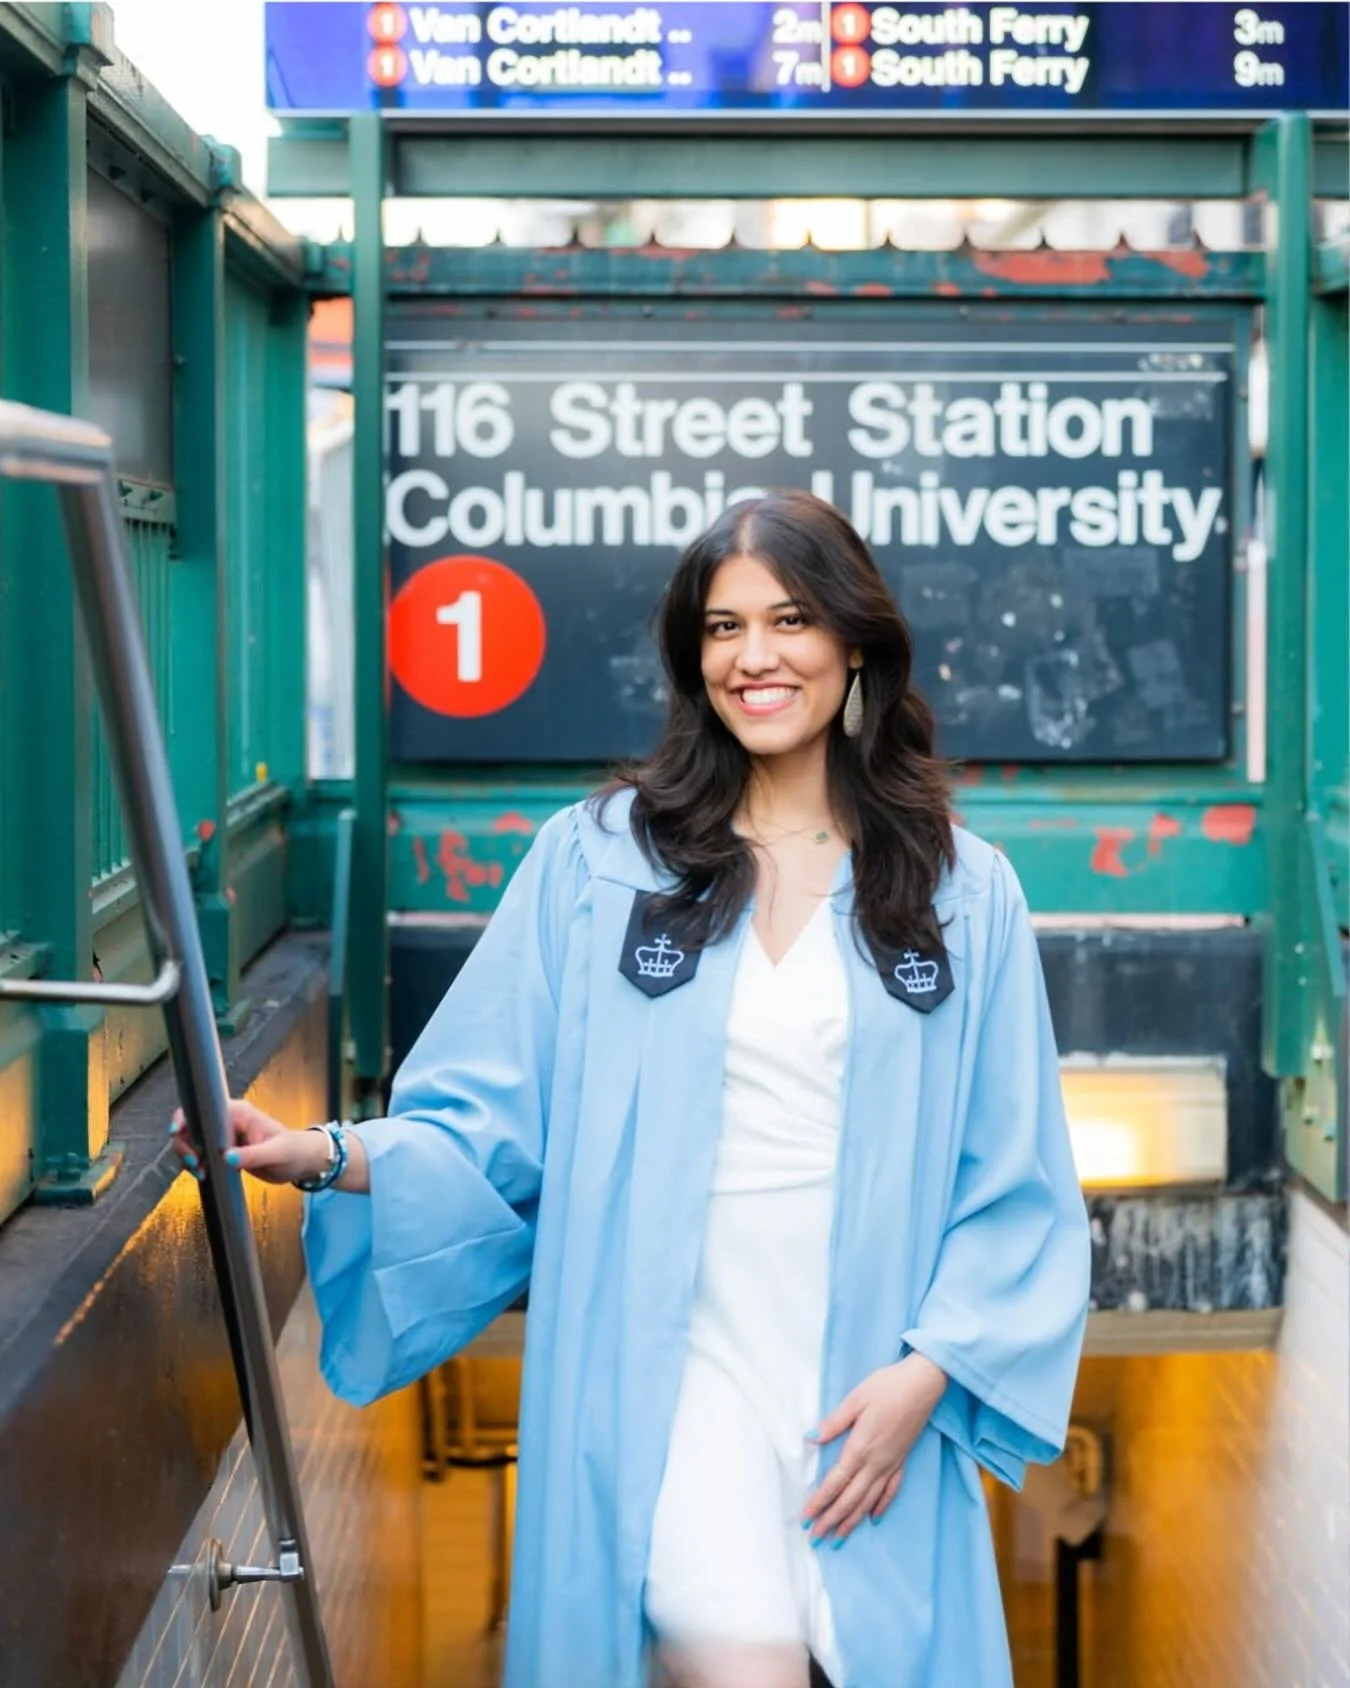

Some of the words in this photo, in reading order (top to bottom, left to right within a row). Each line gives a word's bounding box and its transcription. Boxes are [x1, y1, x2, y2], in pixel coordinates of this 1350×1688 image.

[380, 8, 396, 35] 1
[411, 8, 481, 44] Van
[488, 6, 661, 44] Cortlandt
[773, 11, 822, 43] 2m
[842, 9, 856, 36] 1
[871, 9, 983, 45] South
[990, 9, 1090, 53] Ferry
[1234, 10, 1285, 45] 3m
[380, 51, 396, 78] 1
[411, 50, 481, 86] Van
[488, 48, 664, 86] Cortlandt
[774, 52, 822, 85] 7m
[842, 51, 856, 78] 1
[871, 51, 983, 87] South
[990, 51, 1090, 94] Ferry
[1234, 52, 1285, 87] 9m
[386, 382, 515, 458] 116
[549, 381, 814, 458] Street
[847, 381, 1154, 458] Station
[385, 470, 770, 547] Columbi
[812, 470, 1223, 562] University
[436, 591, 482, 682] 1
